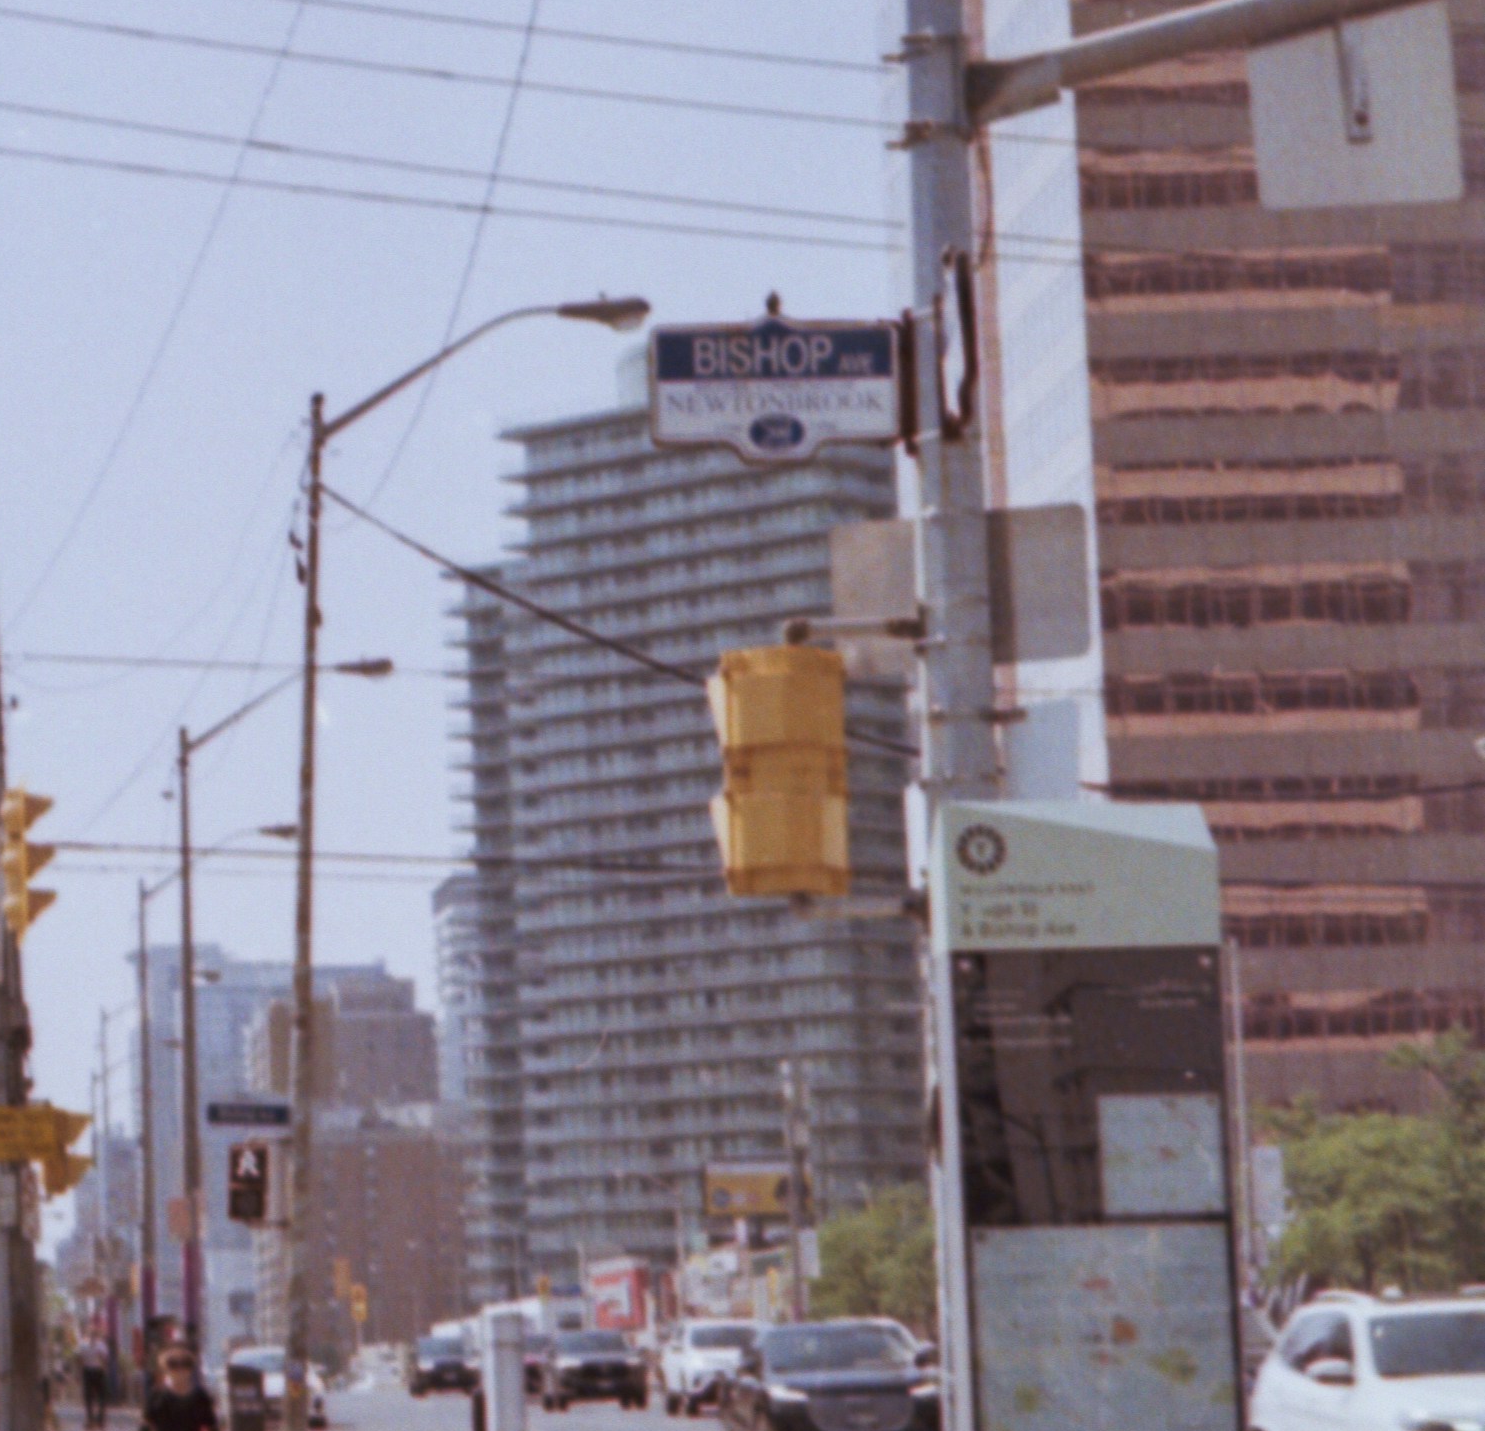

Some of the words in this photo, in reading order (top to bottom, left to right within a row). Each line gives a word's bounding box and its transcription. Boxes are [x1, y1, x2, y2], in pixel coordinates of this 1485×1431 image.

[693, 334, 833, 375] BISHOP
[839, 352, 874, 373] AVE
[667, 391, 883, 413] NEWTONBROOK
